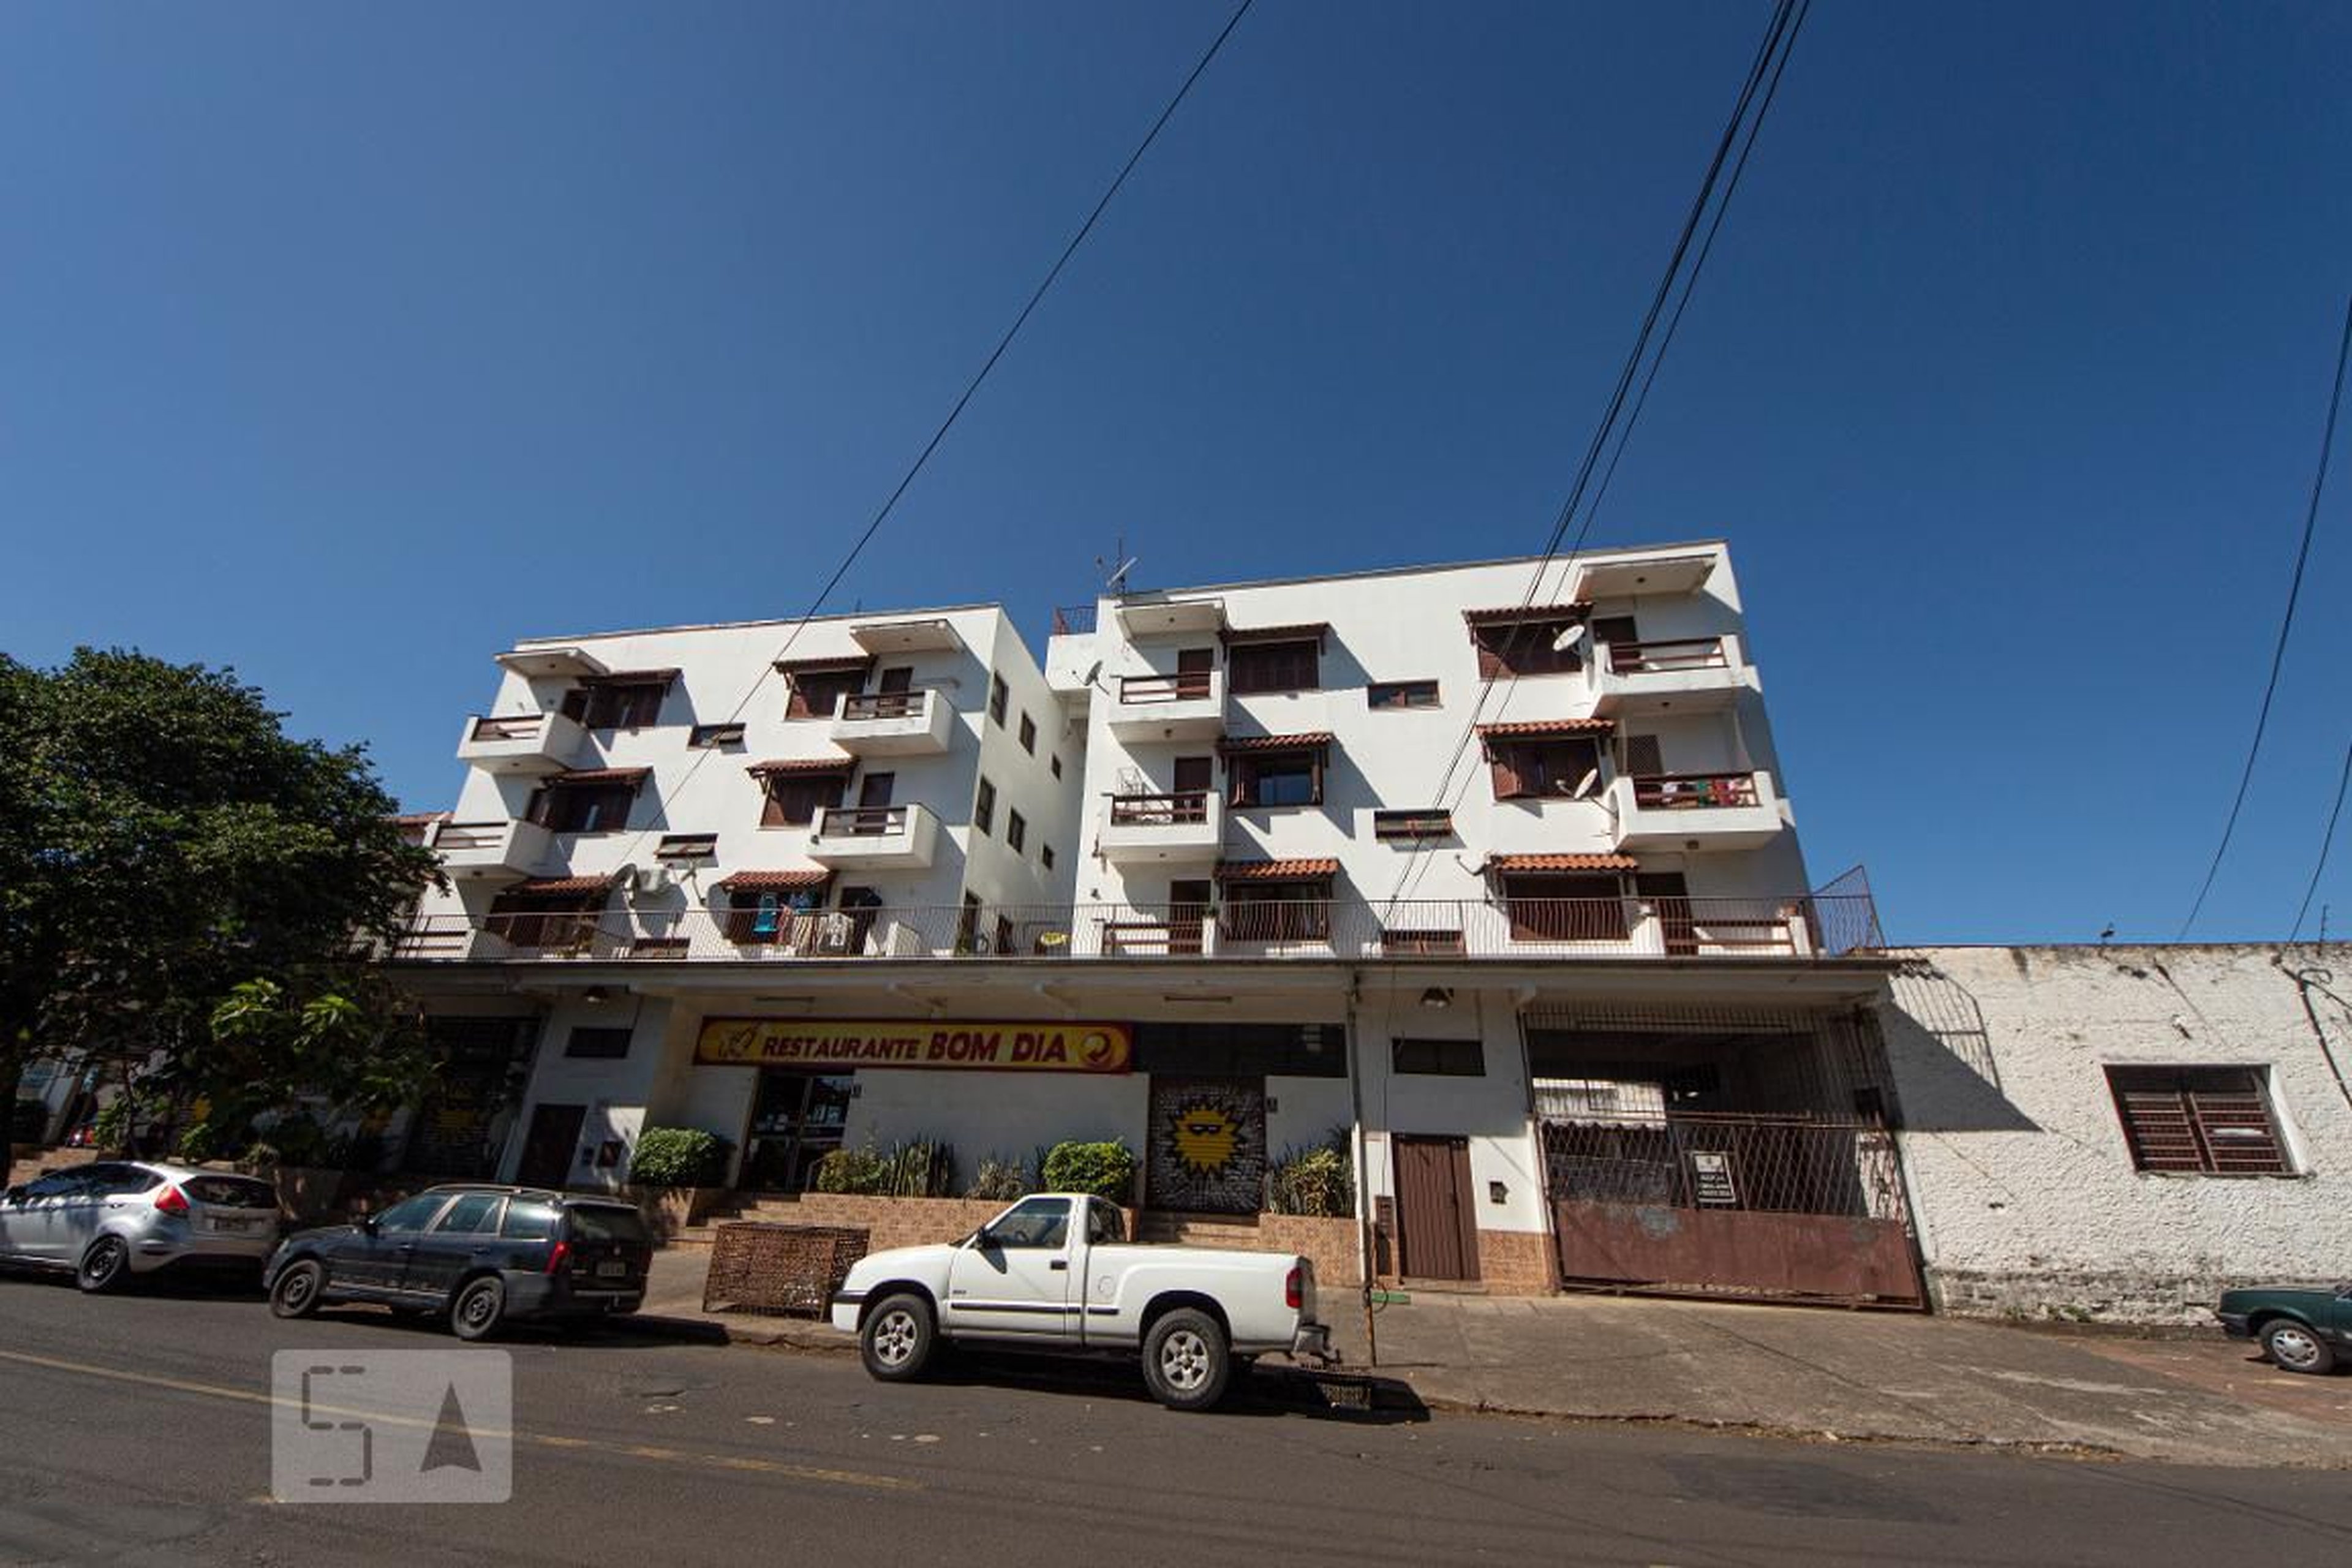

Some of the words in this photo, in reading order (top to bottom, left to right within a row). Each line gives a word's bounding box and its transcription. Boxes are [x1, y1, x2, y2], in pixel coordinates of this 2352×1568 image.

[761, 1036, 920, 1060] RESTAURANTE
[926, 1031, 1002, 1061] BOM
[1010, 1032, 1067, 1062] DIA
